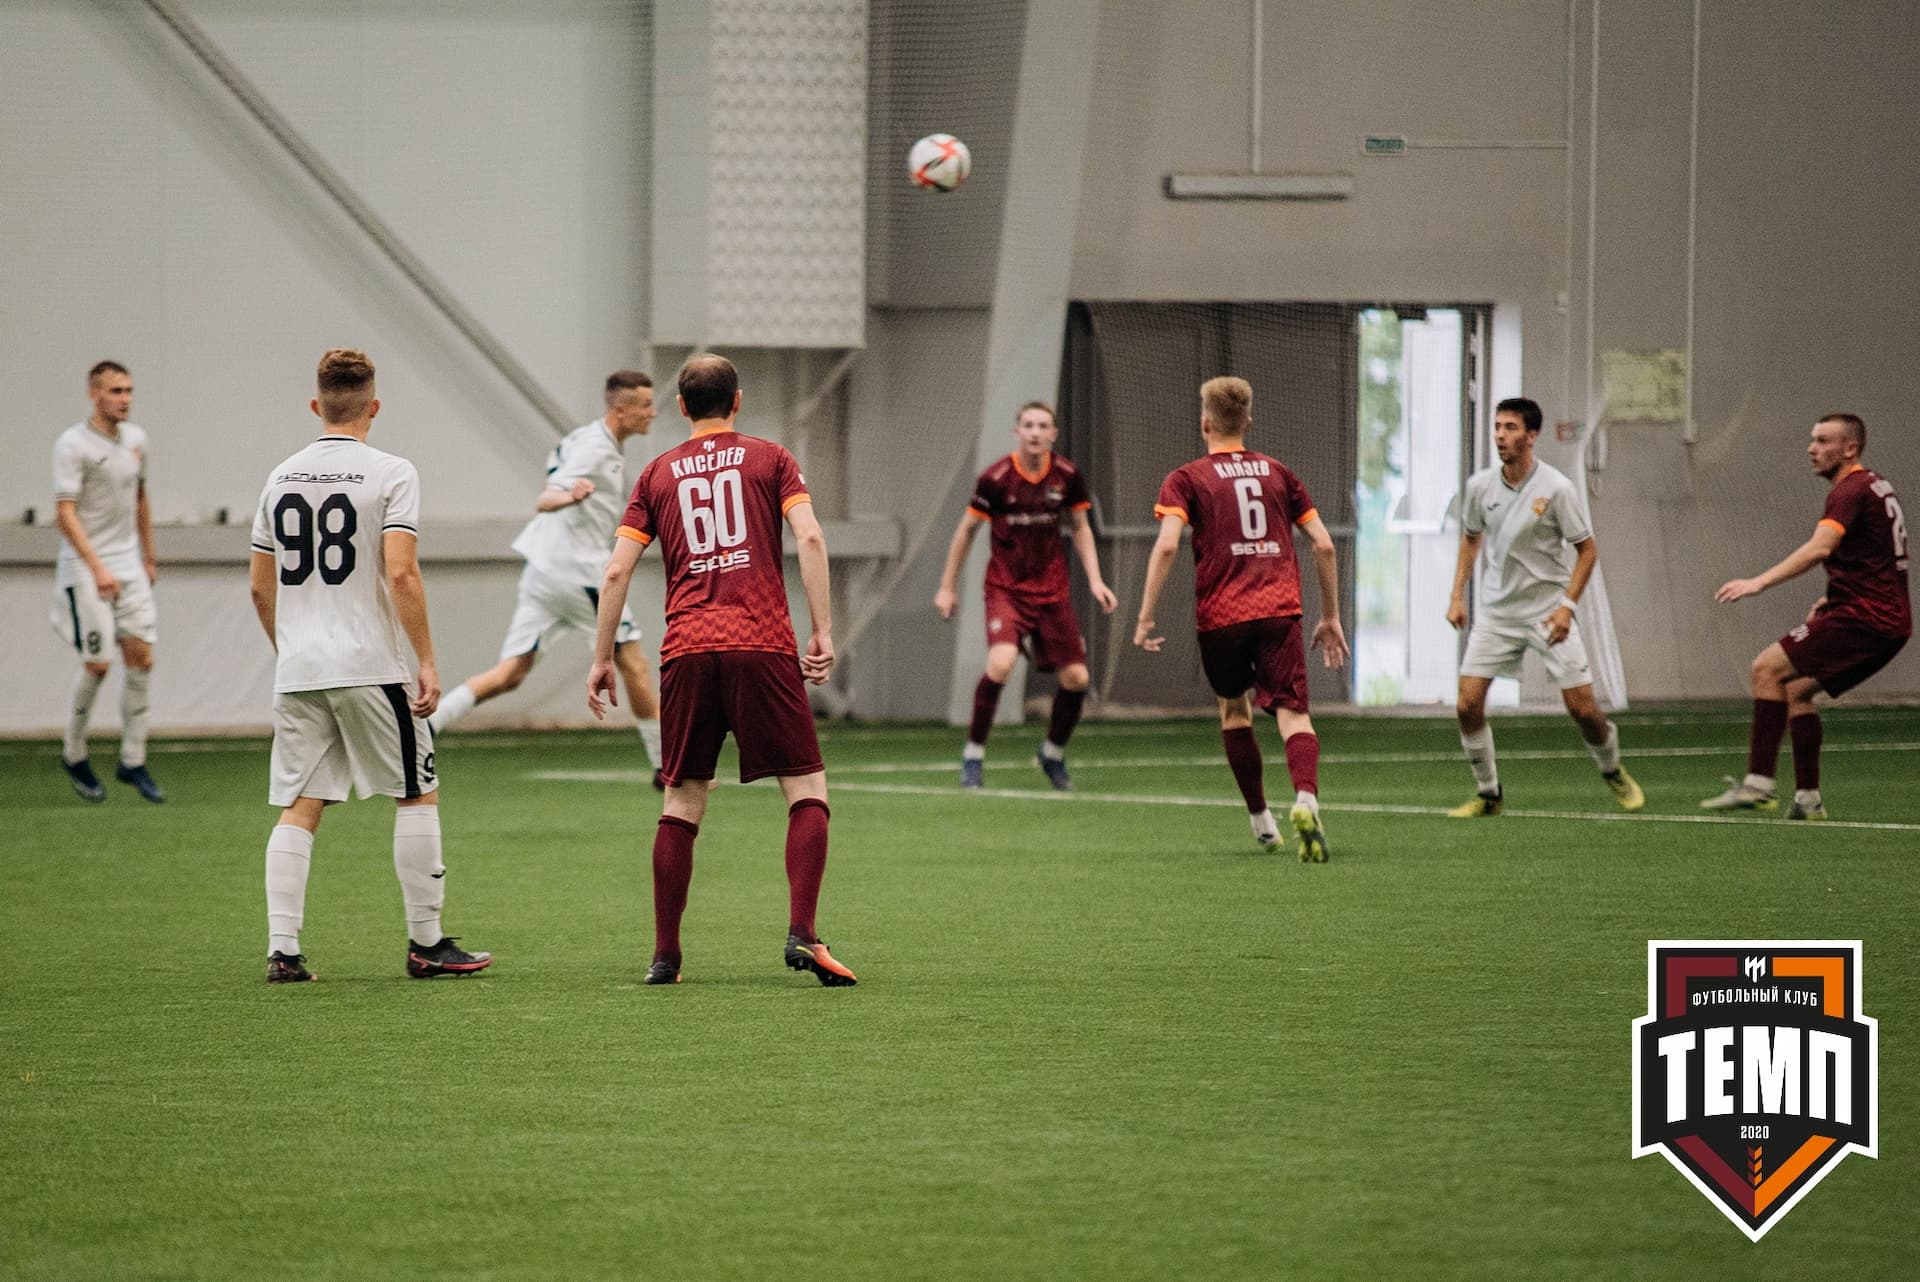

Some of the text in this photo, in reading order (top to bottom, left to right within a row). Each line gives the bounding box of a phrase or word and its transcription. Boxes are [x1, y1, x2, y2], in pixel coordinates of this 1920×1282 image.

[670, 447, 745, 478] КИСЕЛЕВ
[678, 469, 747, 554] 60
[1233, 478, 1267, 539] 6
[273, 493, 357, 586] 98
[688, 549, 751, 574] SEUS
[1231, 541, 1280, 555] SEUS
